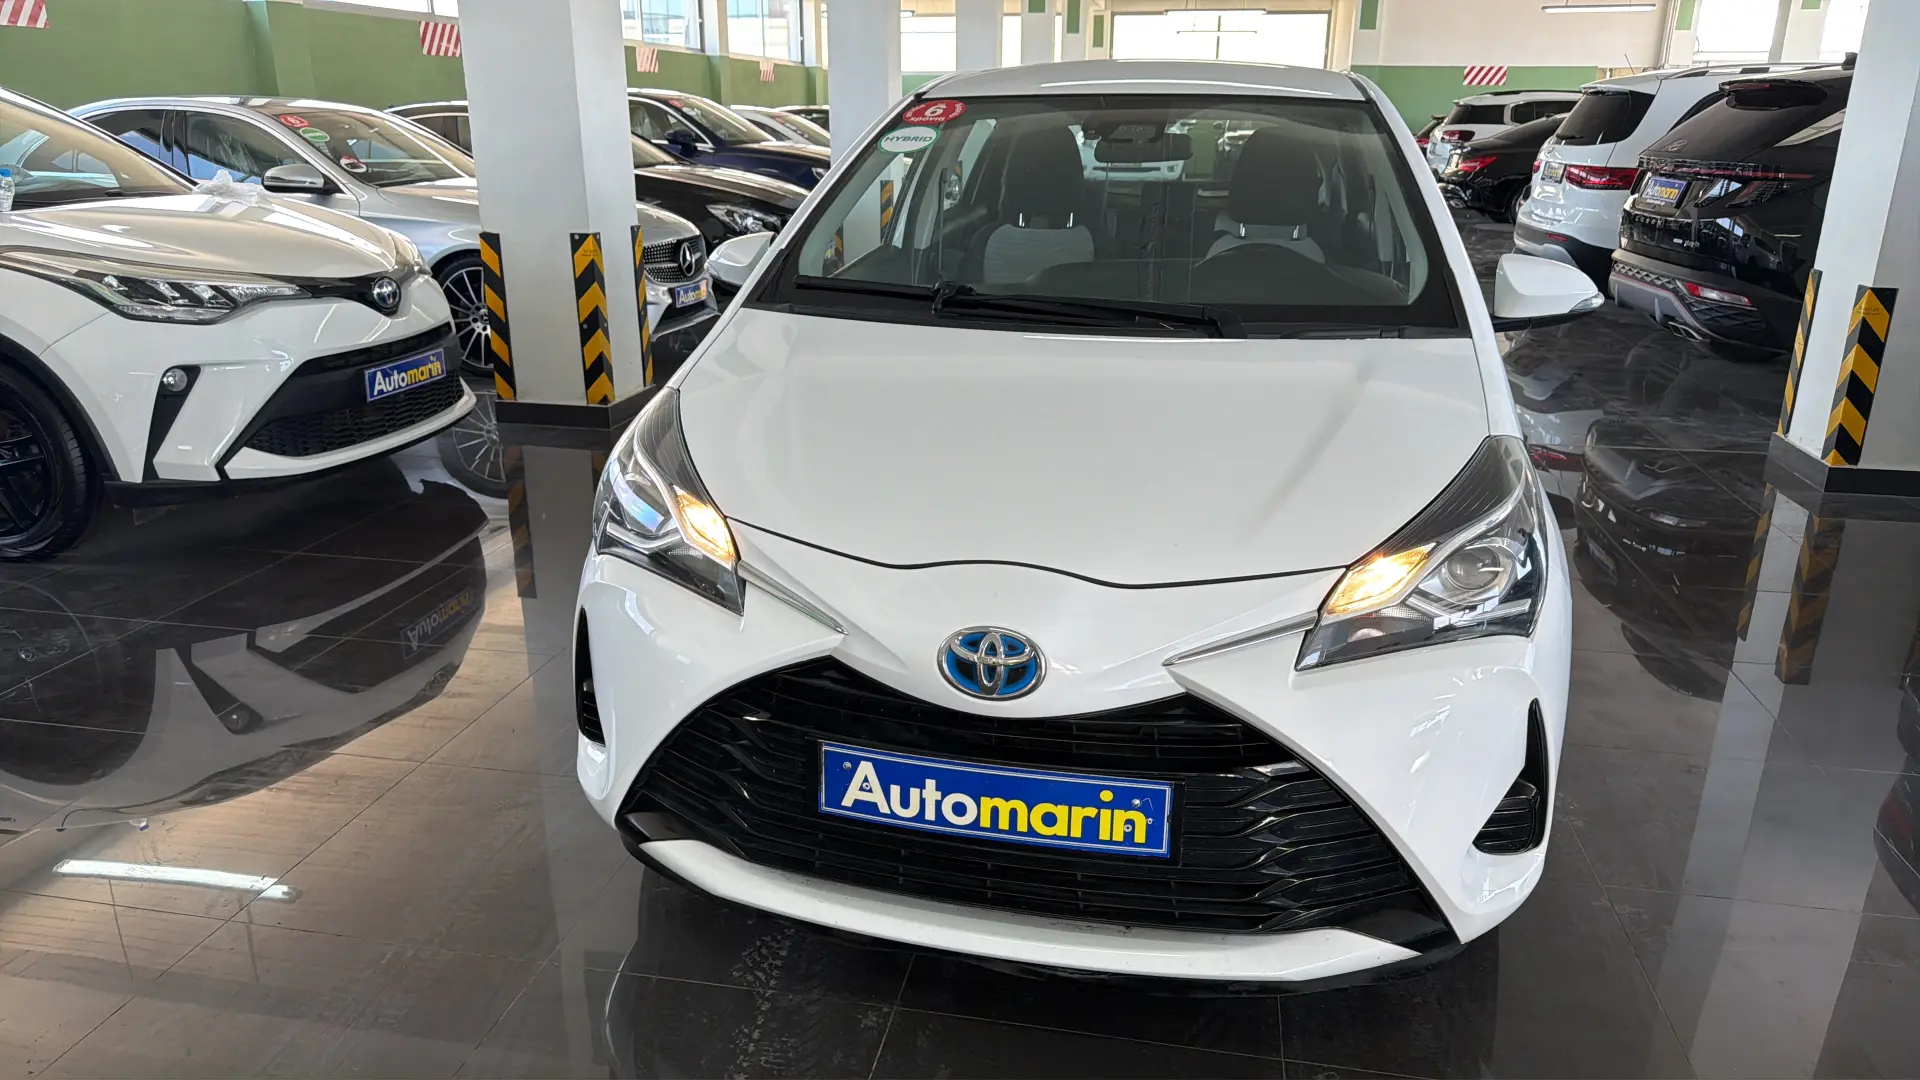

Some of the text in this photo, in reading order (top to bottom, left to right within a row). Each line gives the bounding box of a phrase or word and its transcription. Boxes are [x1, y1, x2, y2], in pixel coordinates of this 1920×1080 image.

[924, 105, 946, 117] 6
[885, 135, 933, 143] HYBRID
[374, 355, 442, 396] Automarin
[841, 760, 1148, 844] Automarin
